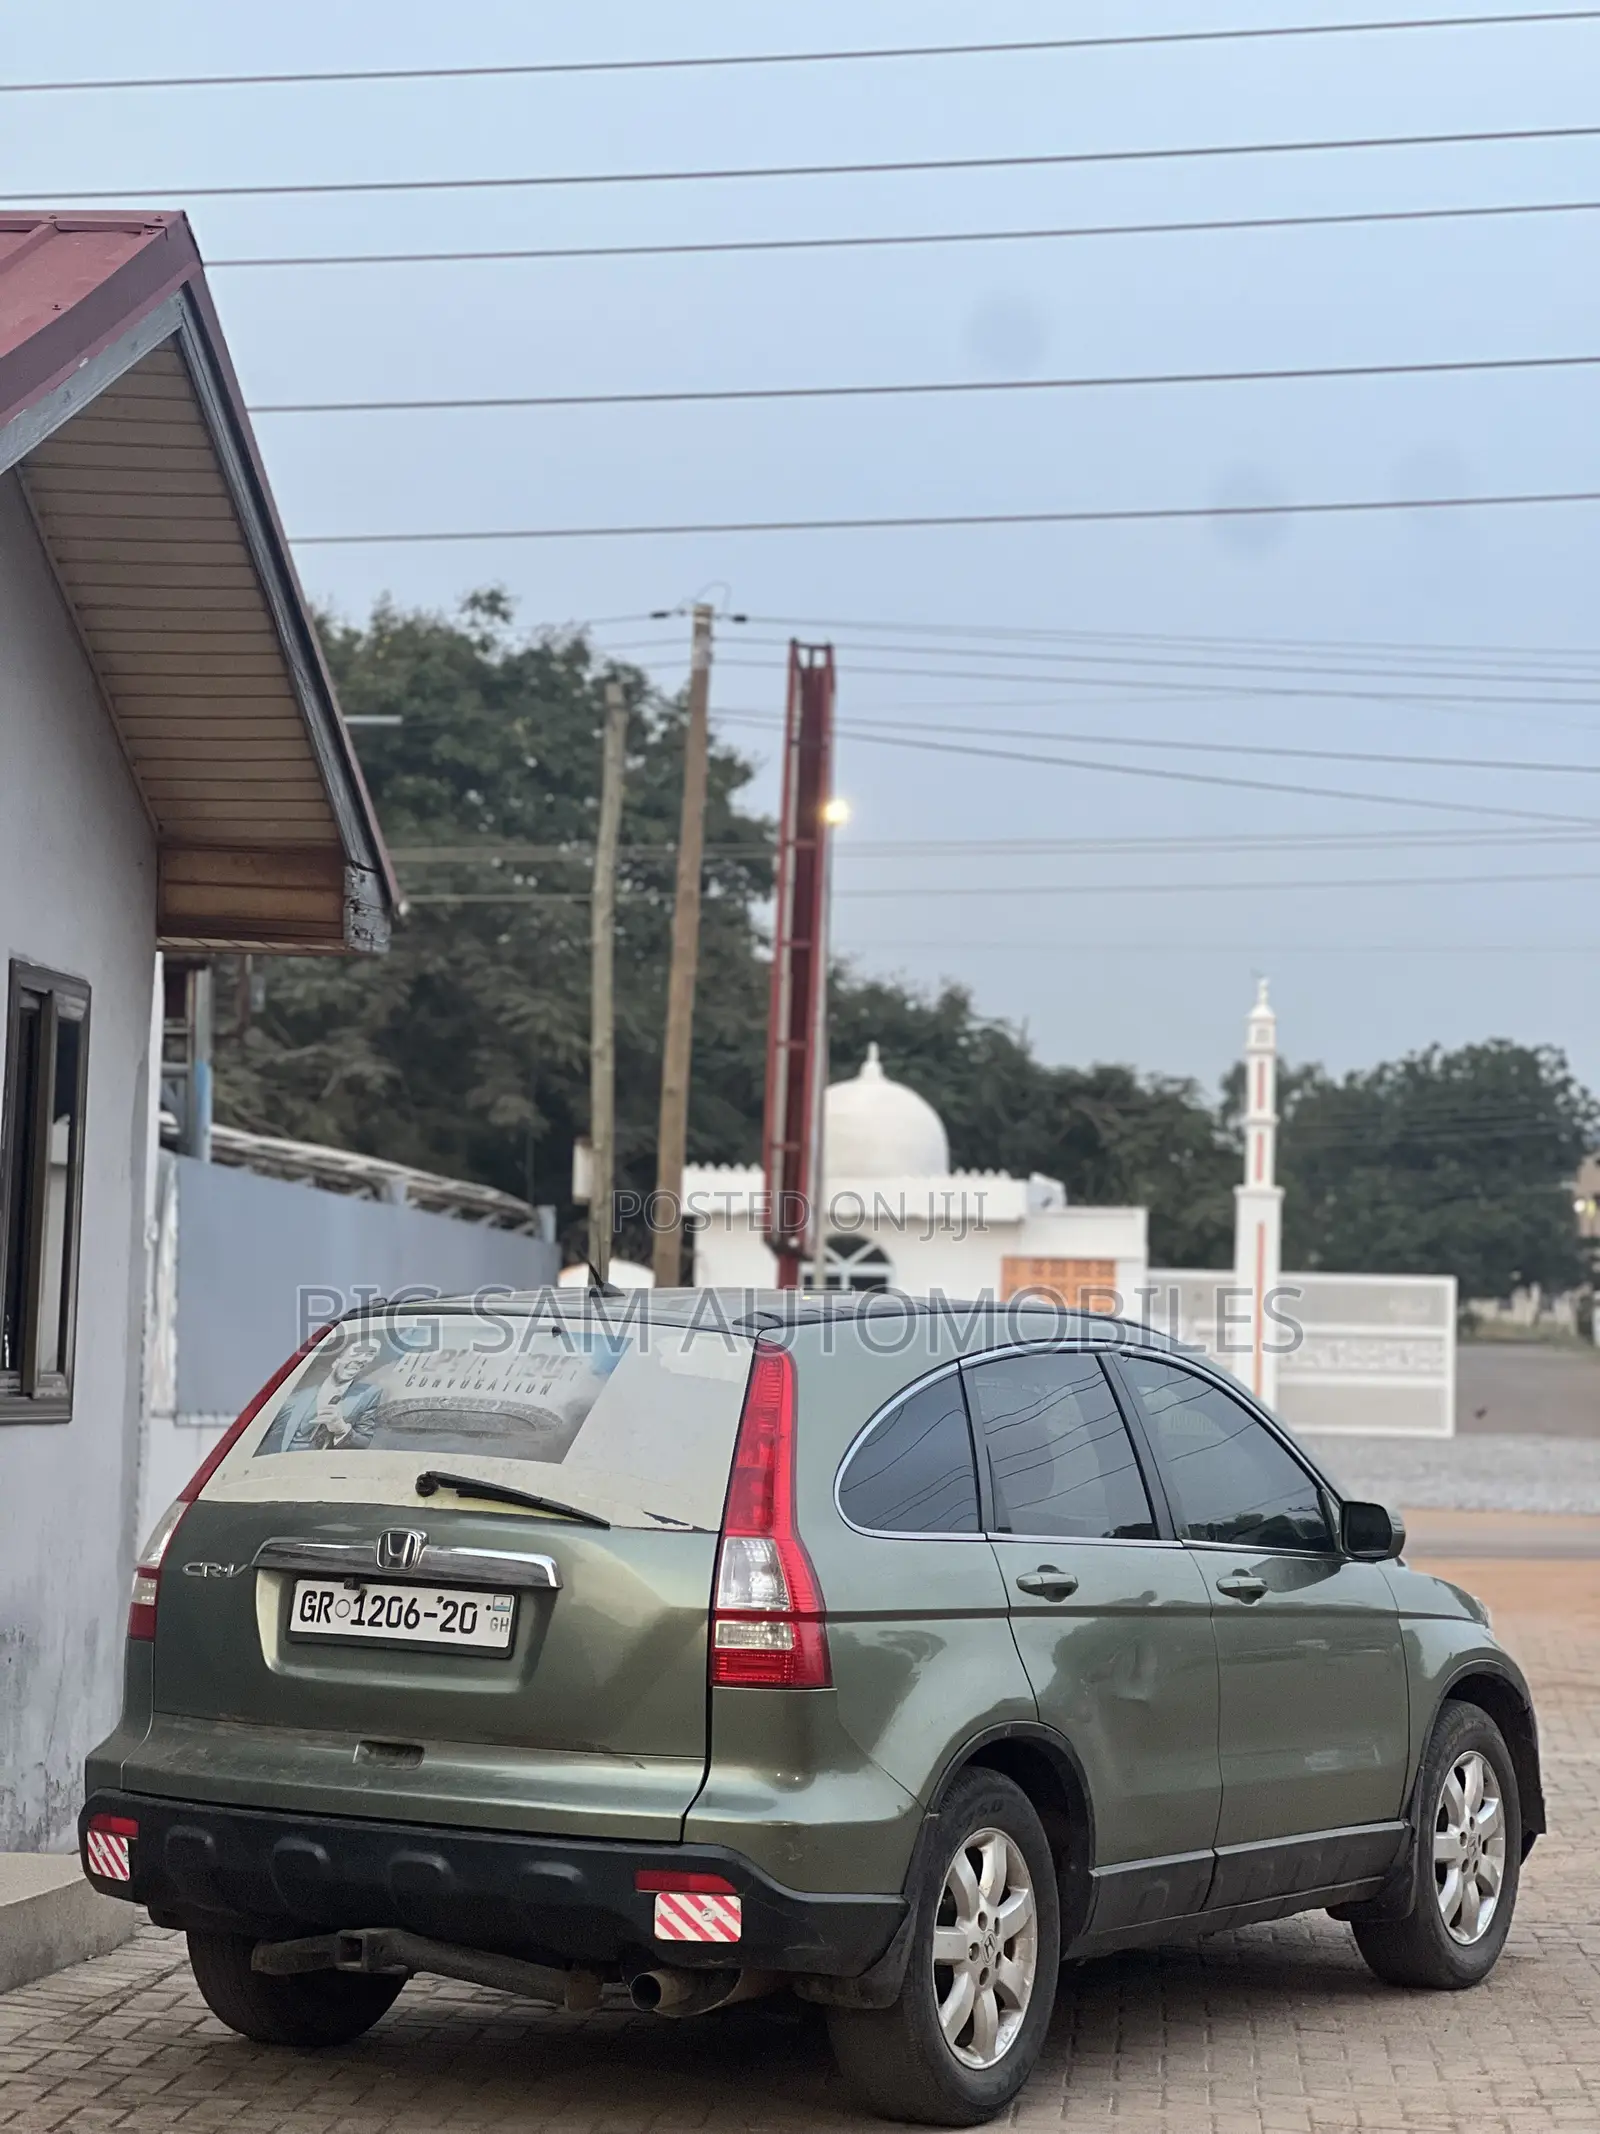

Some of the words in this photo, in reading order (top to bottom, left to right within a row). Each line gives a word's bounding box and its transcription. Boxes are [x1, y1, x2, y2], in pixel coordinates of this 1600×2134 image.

[405, 1374, 553, 1396] CONVOCATION
[182, 1561, 248, 1578] CR-V
[300, 1590, 333, 1624] GR
[350, 1594, 478, 1634] 1206-20
[489, 1616, 509, 1633] GH
